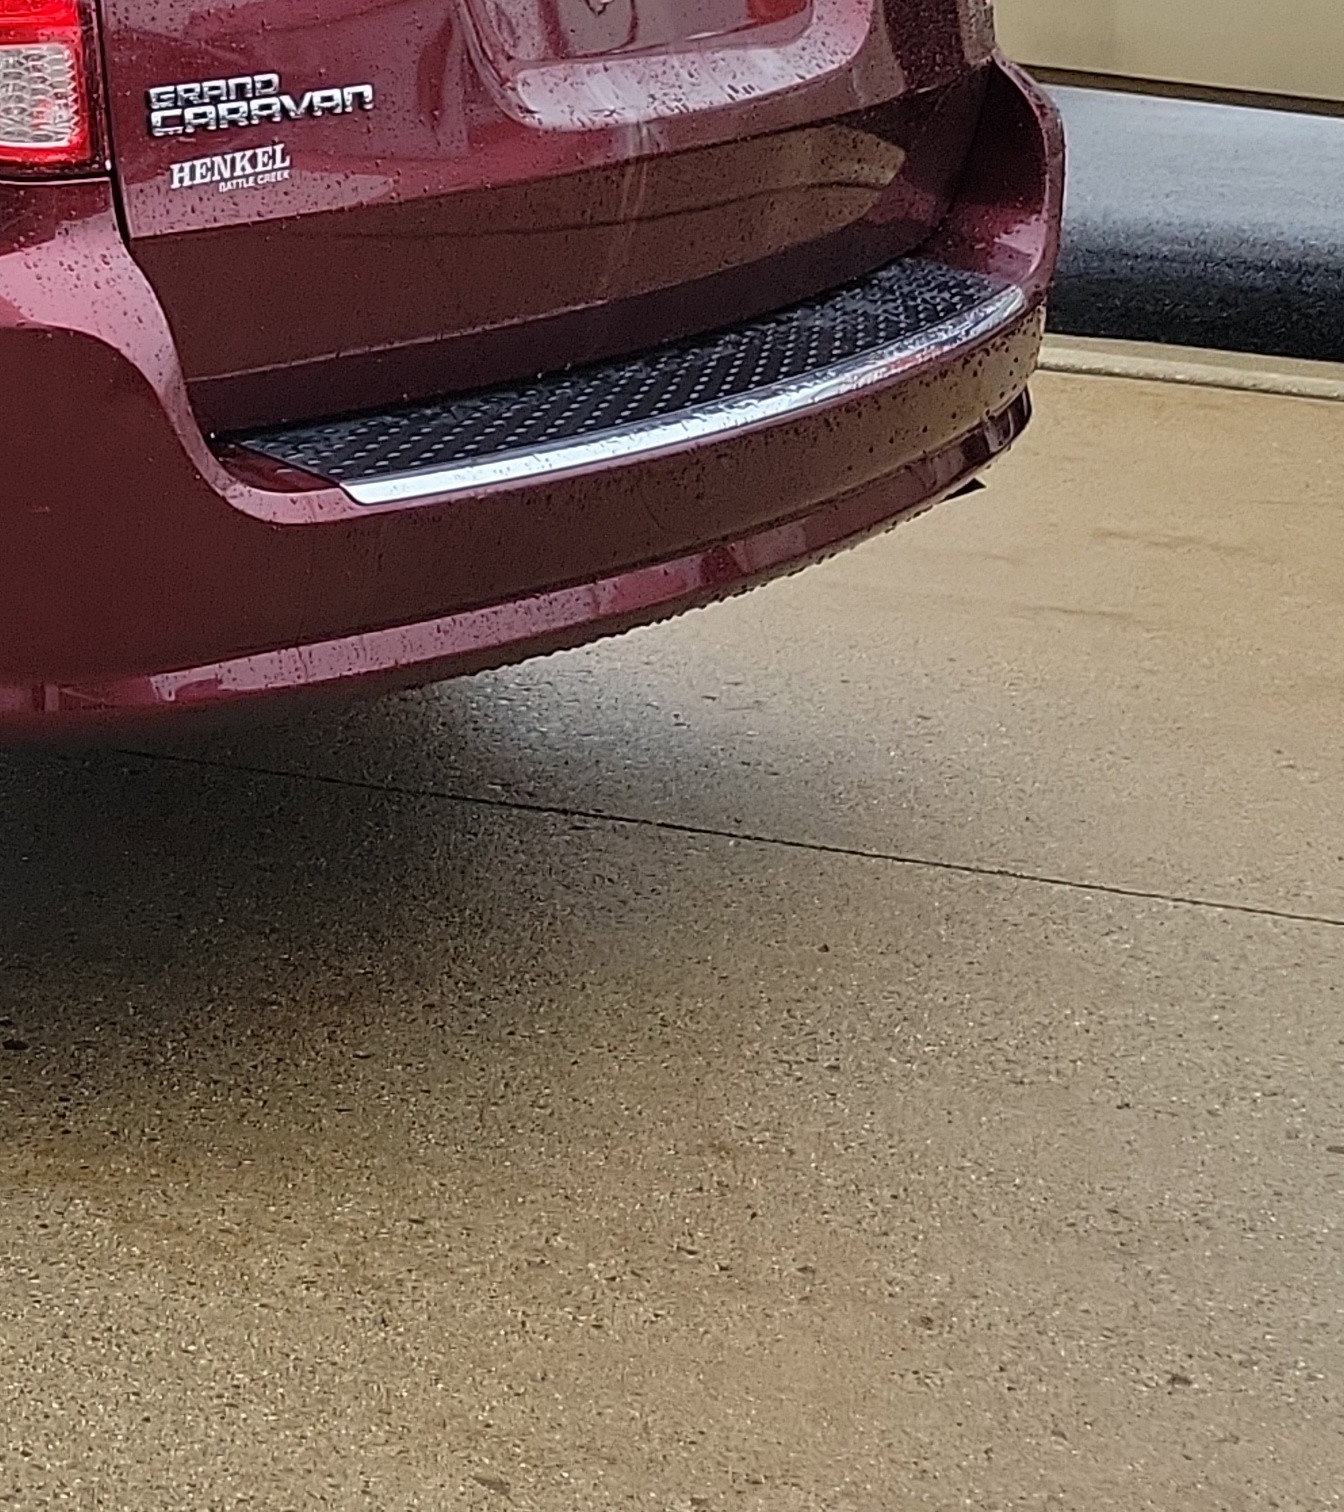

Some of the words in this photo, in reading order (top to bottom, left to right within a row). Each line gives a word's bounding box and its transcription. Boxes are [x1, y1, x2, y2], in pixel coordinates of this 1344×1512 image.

[149, 73, 279, 109] GRAND
[151, 84, 374, 137] CARAVAN
[169, 142, 292, 190] HENKEL
